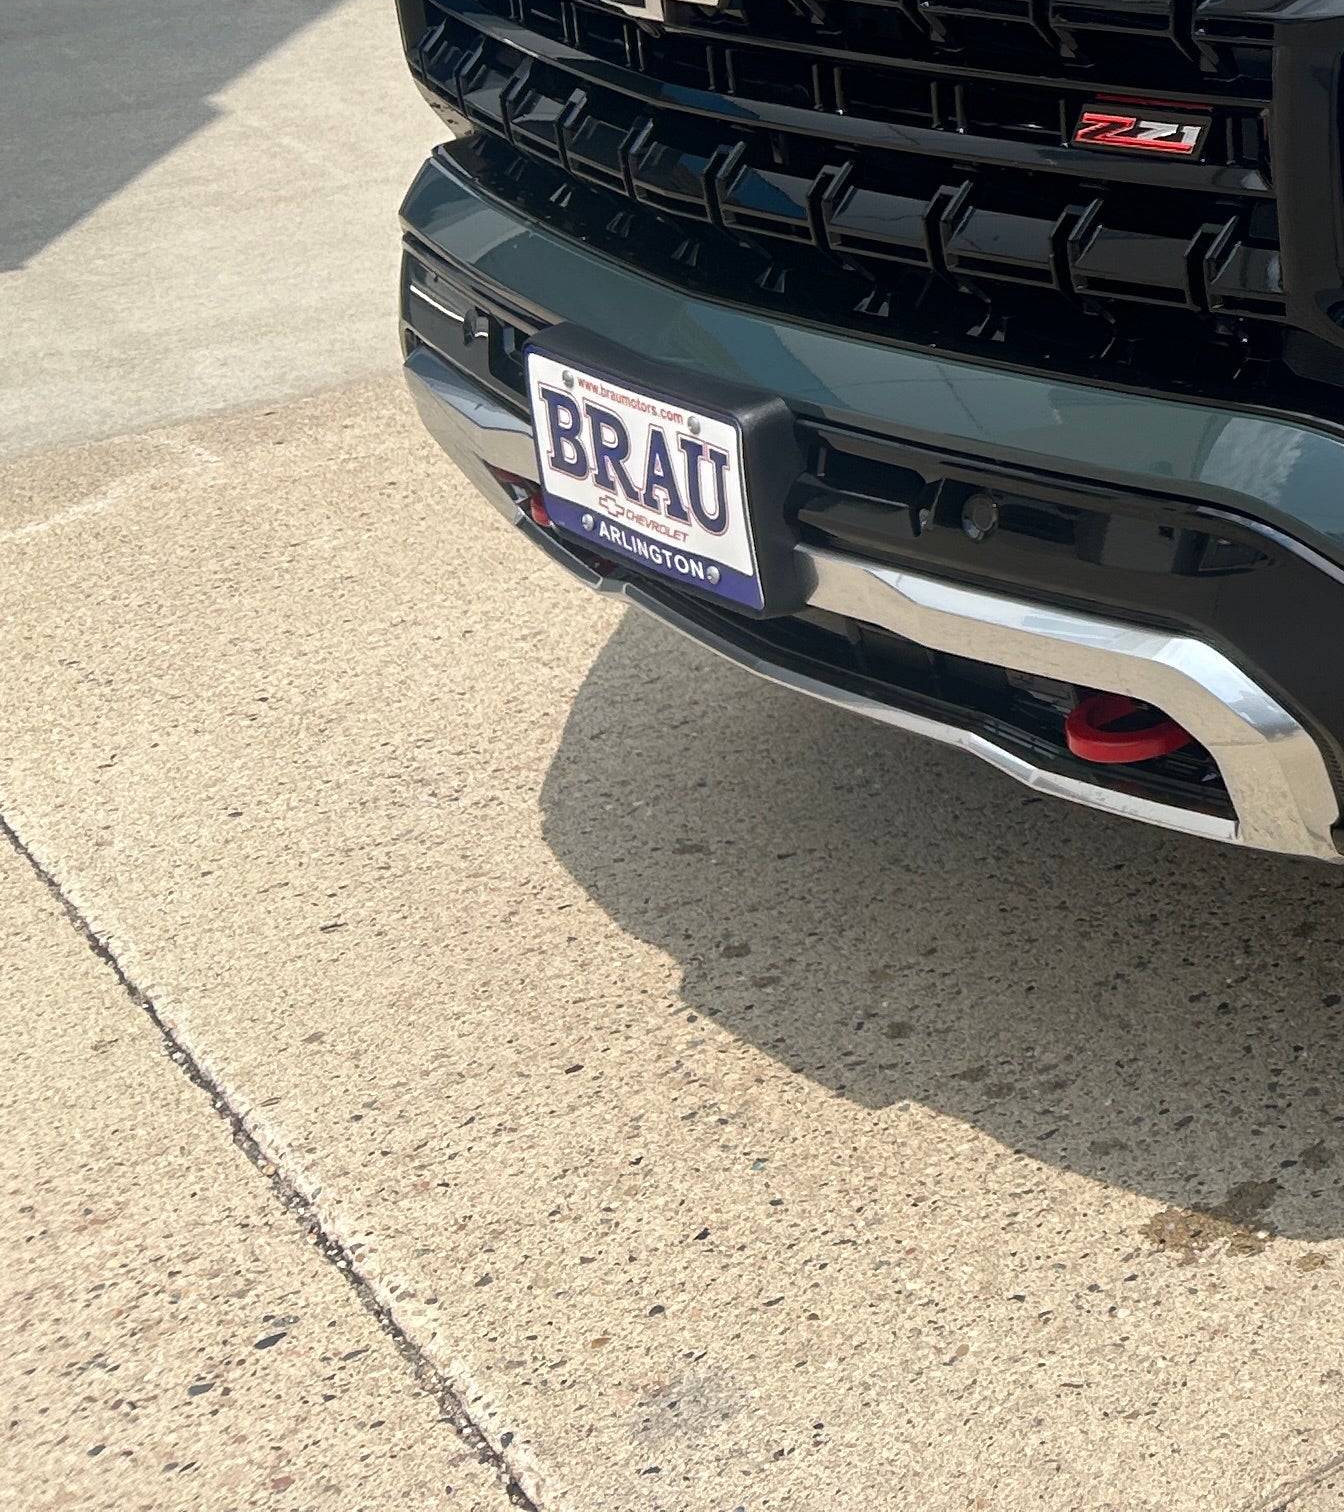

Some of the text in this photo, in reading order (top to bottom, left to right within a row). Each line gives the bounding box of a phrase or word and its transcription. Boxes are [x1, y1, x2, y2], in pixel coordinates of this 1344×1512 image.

[1074, 111, 1202, 155] Z71
[576, 376, 684, 426] www.braumotors.com
[537, 381, 731, 537] BRAU
[598, 520, 706, 581] ARLINGTON
[625, 509, 690, 543] CHEVROLET
